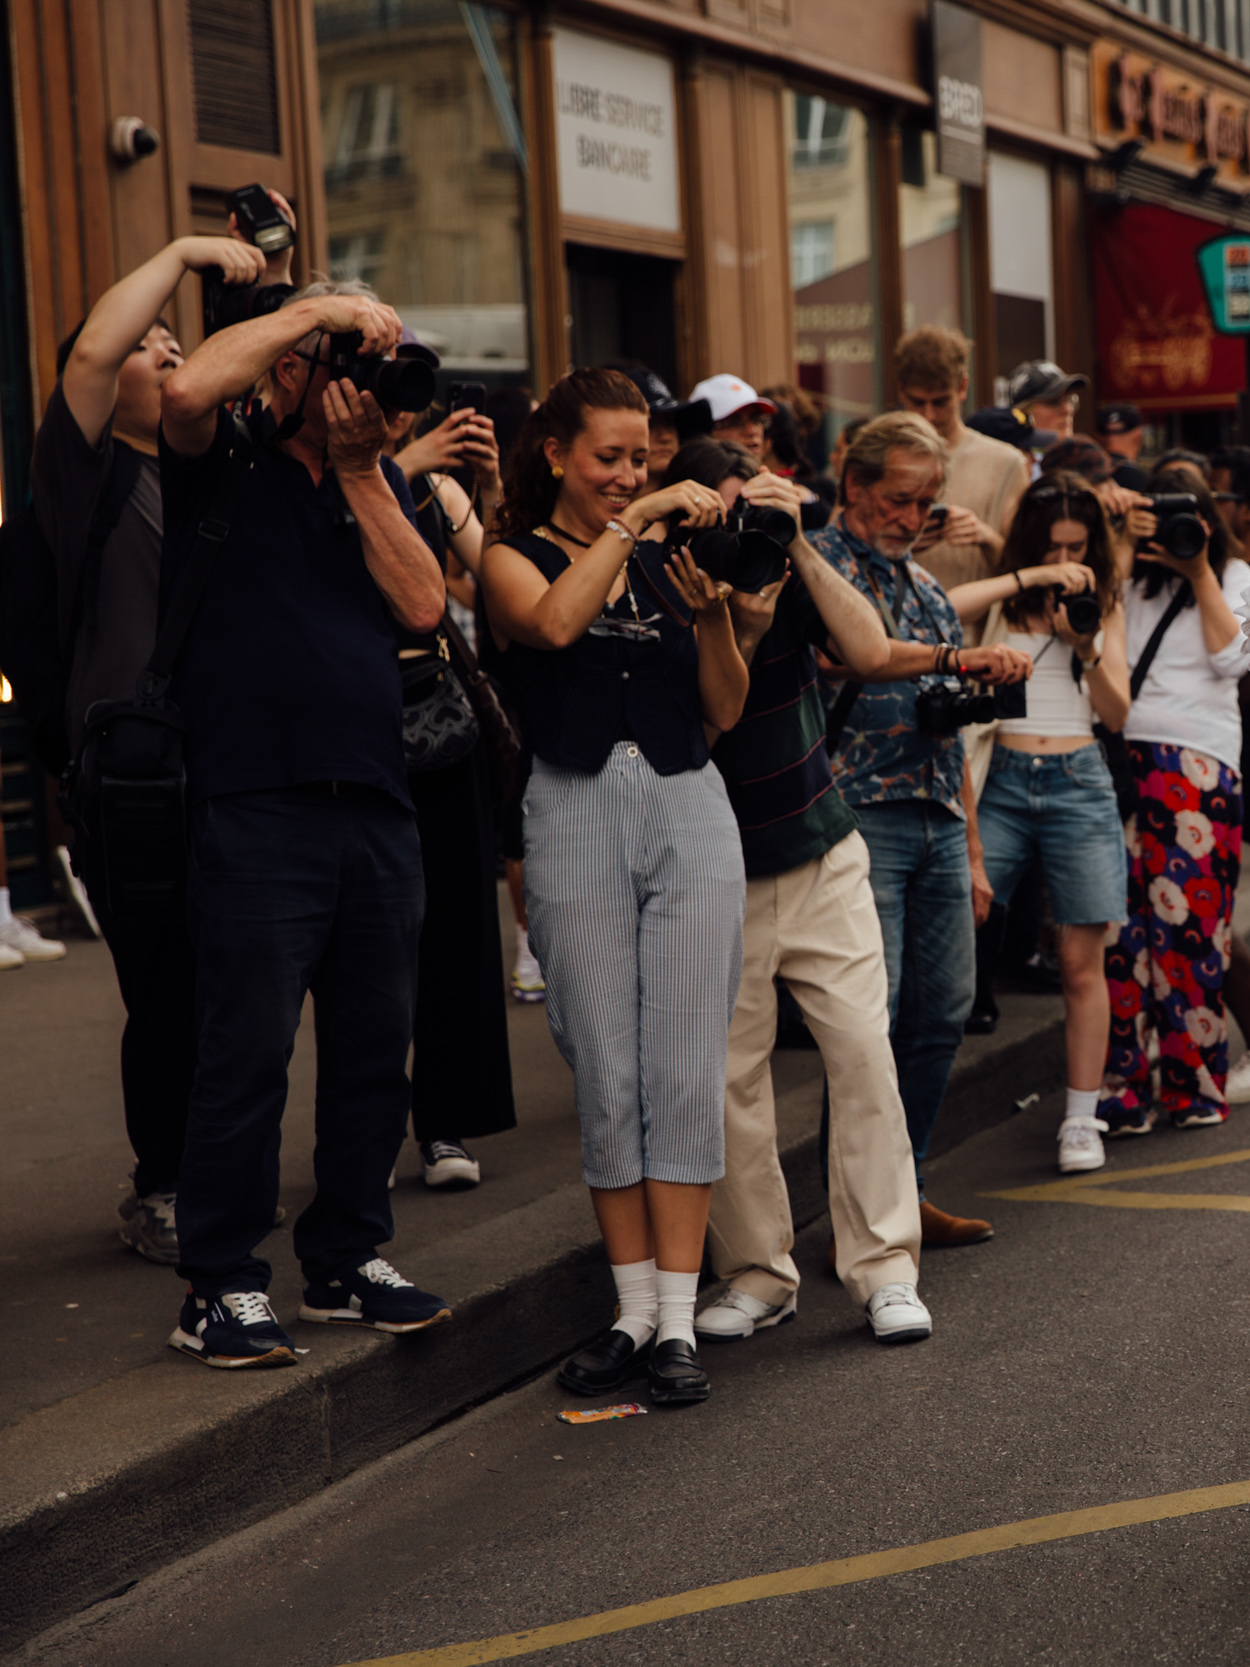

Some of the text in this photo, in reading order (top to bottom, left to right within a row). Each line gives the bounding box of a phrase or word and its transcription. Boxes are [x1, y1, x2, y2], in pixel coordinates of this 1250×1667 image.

[557, 79, 666, 138] LIBRE SERVICE
[577, 134, 652, 182] BANCAIRE
